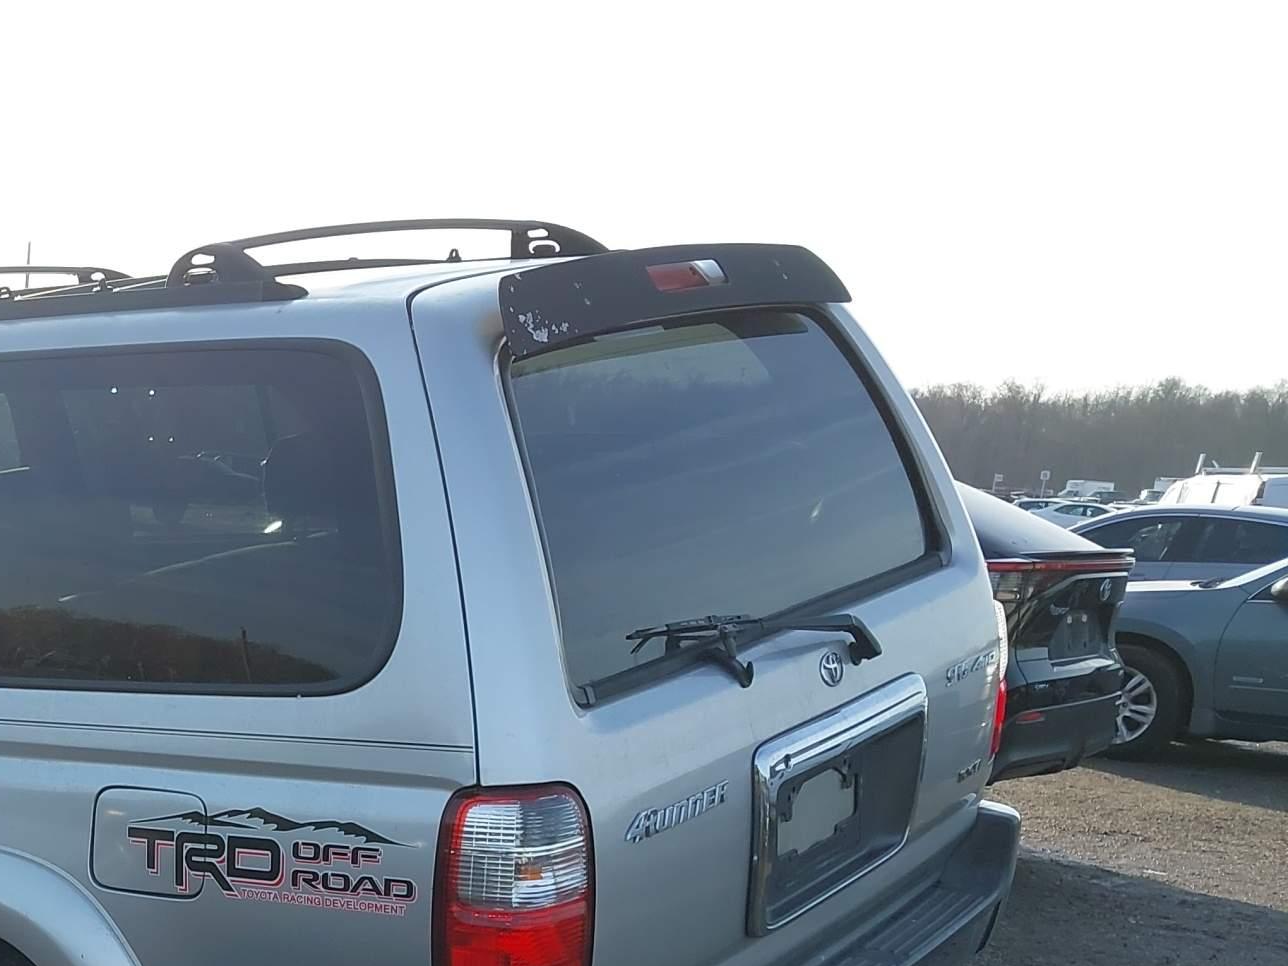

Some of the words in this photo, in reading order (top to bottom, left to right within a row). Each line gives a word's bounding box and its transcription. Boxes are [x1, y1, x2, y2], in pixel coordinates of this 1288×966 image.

[127, 826, 285, 898] TRD
[291, 840, 383, 868] OFF
[241, 888, 280, 901] TOYOTA
[282, 893, 322, 907] RACING
[324, 897, 406, 915] DEVELOPMENT
[291, 869, 417, 902] ROAD
